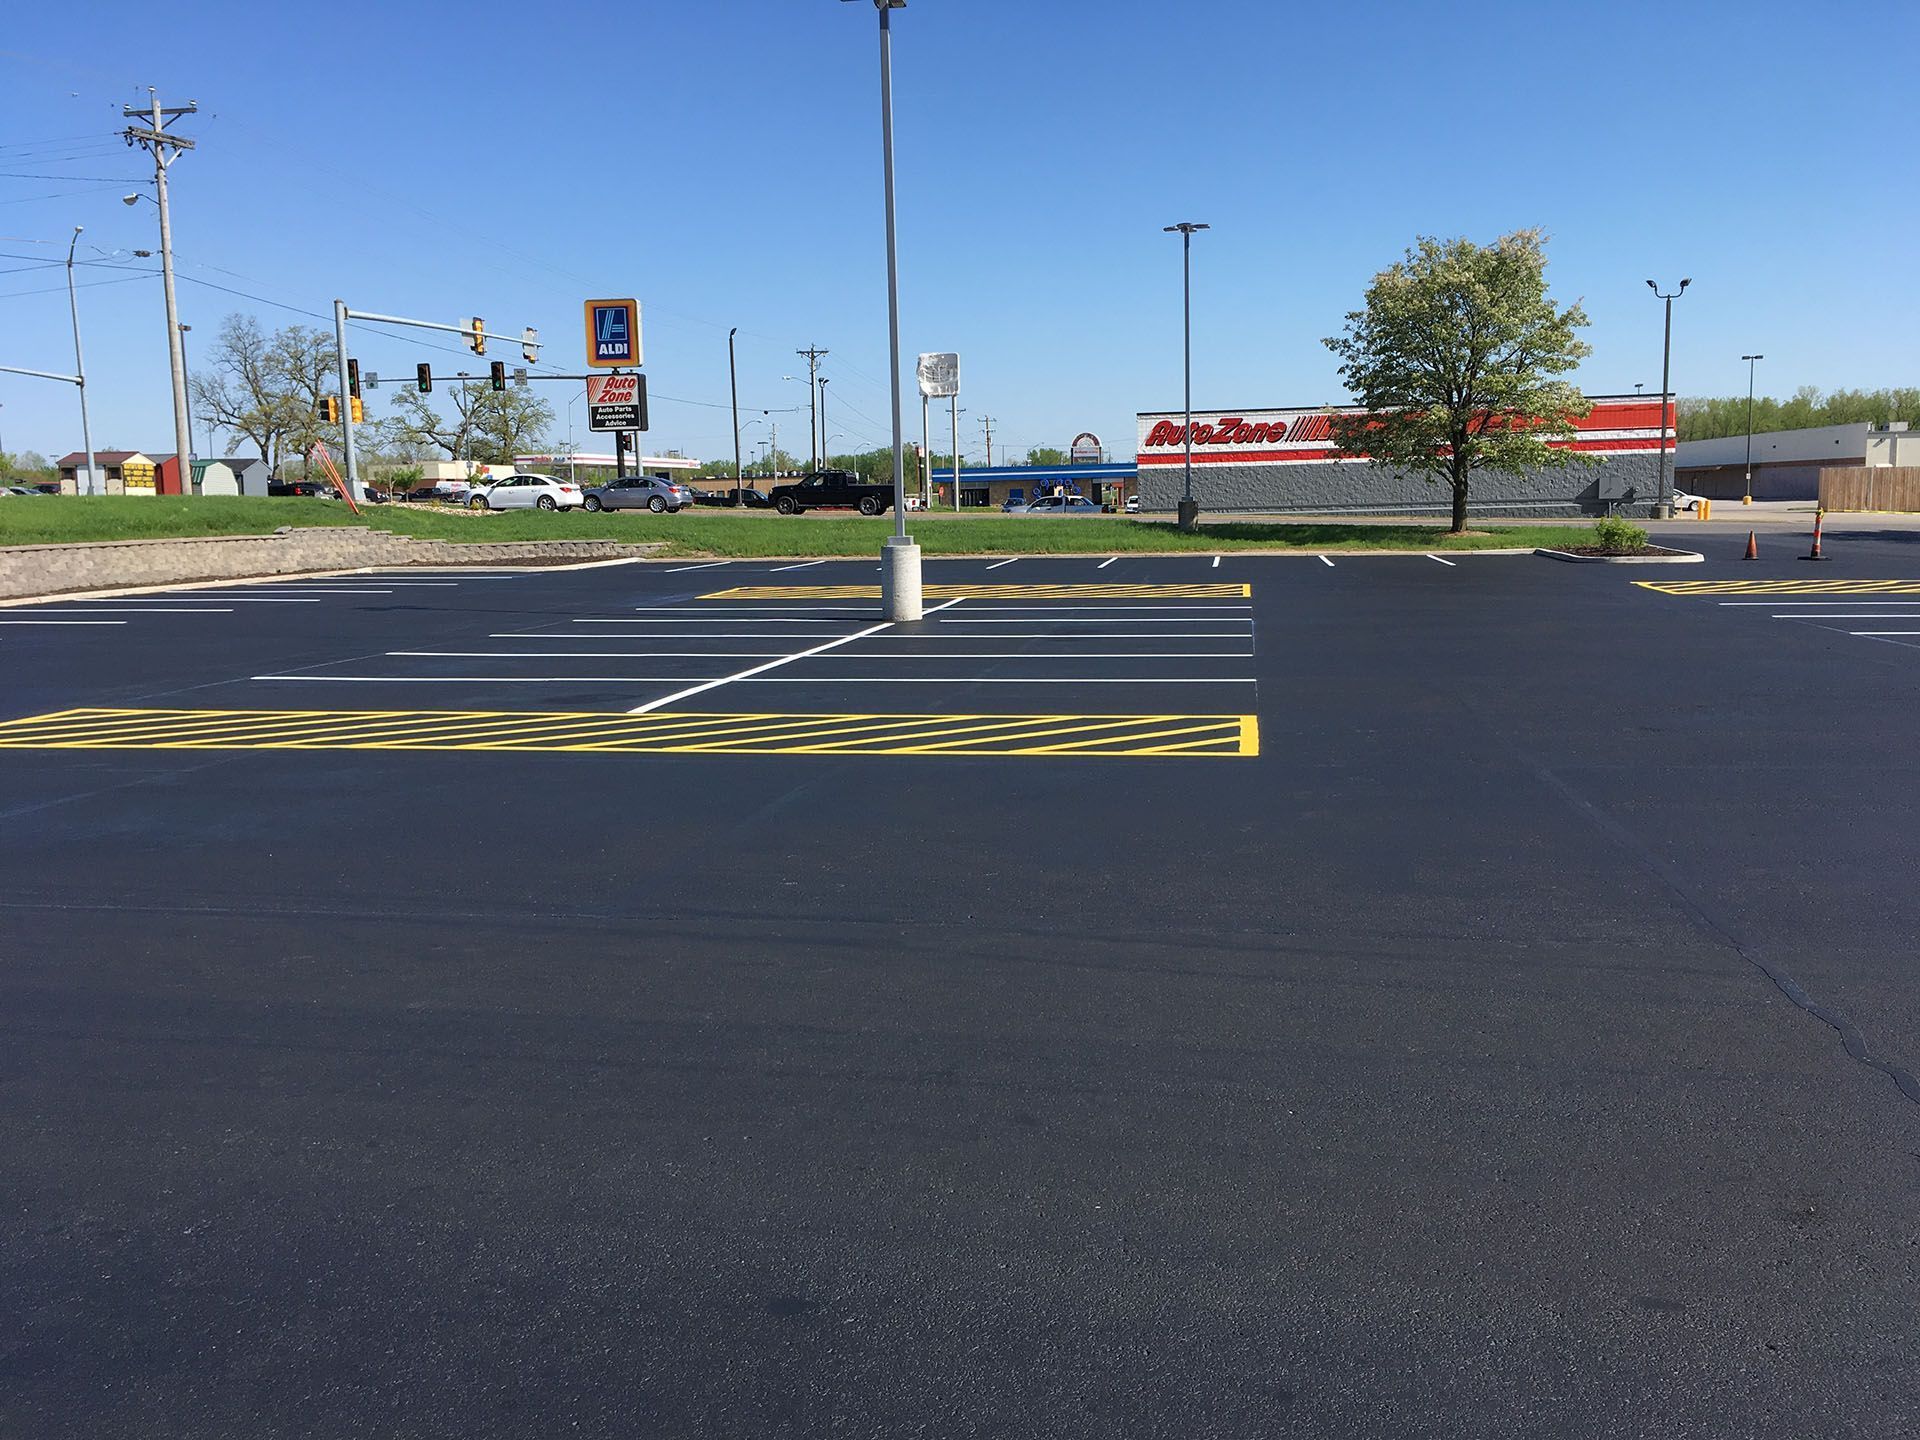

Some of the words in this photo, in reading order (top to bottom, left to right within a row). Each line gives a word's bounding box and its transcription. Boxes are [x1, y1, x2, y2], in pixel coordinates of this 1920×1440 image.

[599, 343, 628, 355] ALDI
[604, 376, 636, 389] Auto
[597, 390, 632, 402] Zone
[1145, 417, 1288, 446] AutoZone
